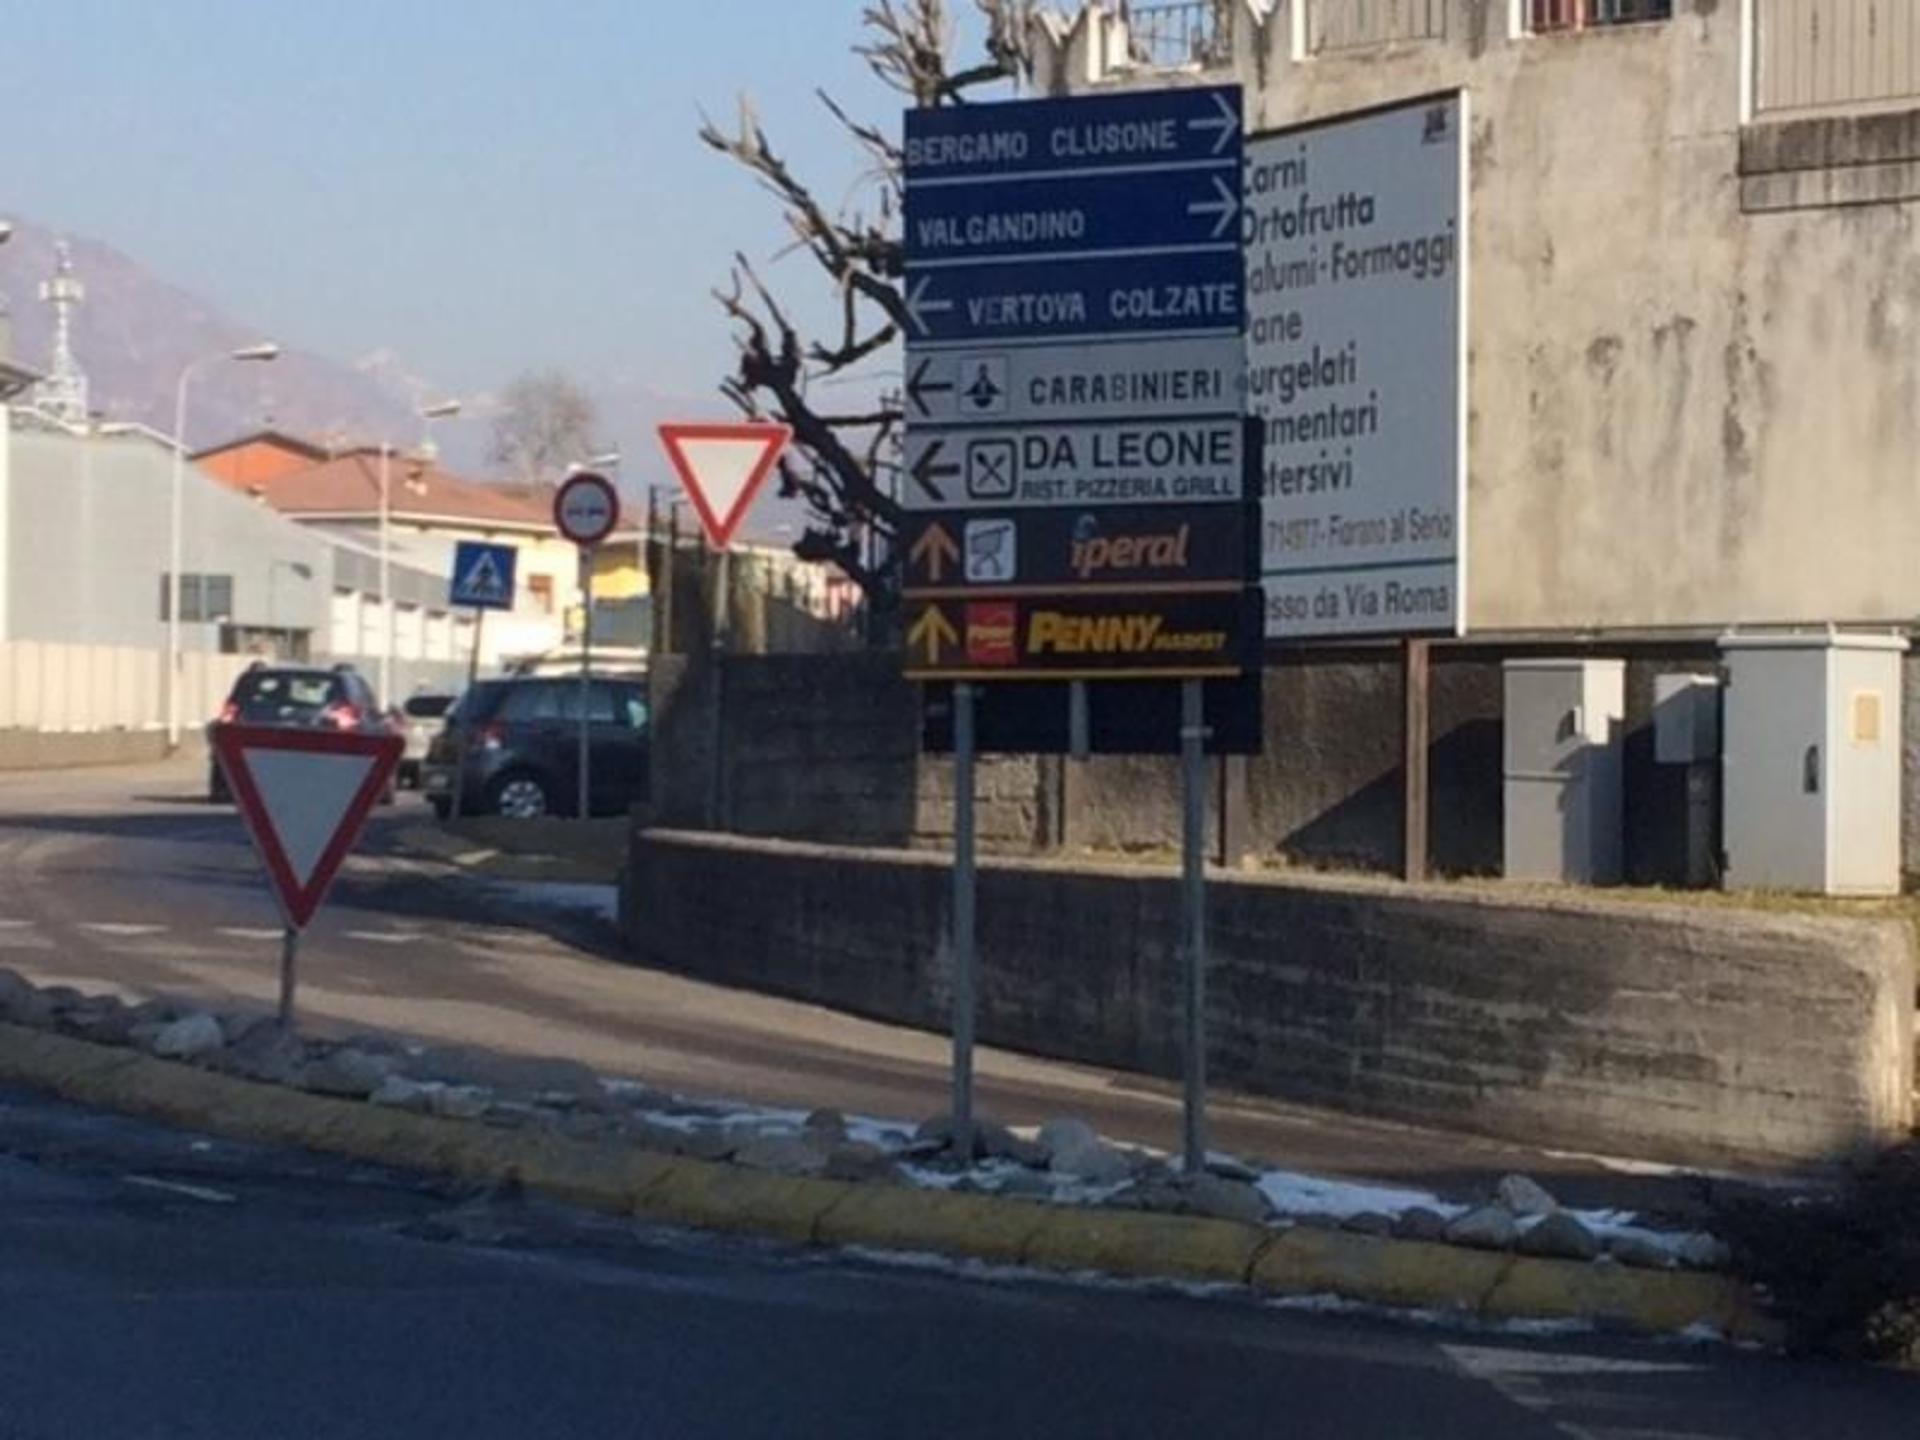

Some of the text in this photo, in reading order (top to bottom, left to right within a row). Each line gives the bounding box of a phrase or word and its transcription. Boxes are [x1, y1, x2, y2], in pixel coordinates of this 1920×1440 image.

[906, 120, 1177, 167] BERGAMO CLUSONE
[917, 210, 1085, 248] VALGANDINO
[1250, 218, 1454, 294] alumi-Formaggi
[967, 284, 1238, 325] VERTOVA COLZATE
[1251, 311, 1303, 346] ane
[1029, 369, 1222, 406] CARABINIERI
[1250, 340, 1357, 403] urgelati
[1254, 389, 1377, 445] imentari
[1023, 429, 1234, 470] DA LEONE
[1075, 477, 1167, 498] PIZZERIA
[1172, 475, 1235, 496] GRILL
[1071, 516, 1190, 578] iperal
[1344, 582, 1379, 616] Via
[1385, 580, 1449, 615] Roma
[1027, 611, 1163, 654] PENNY
